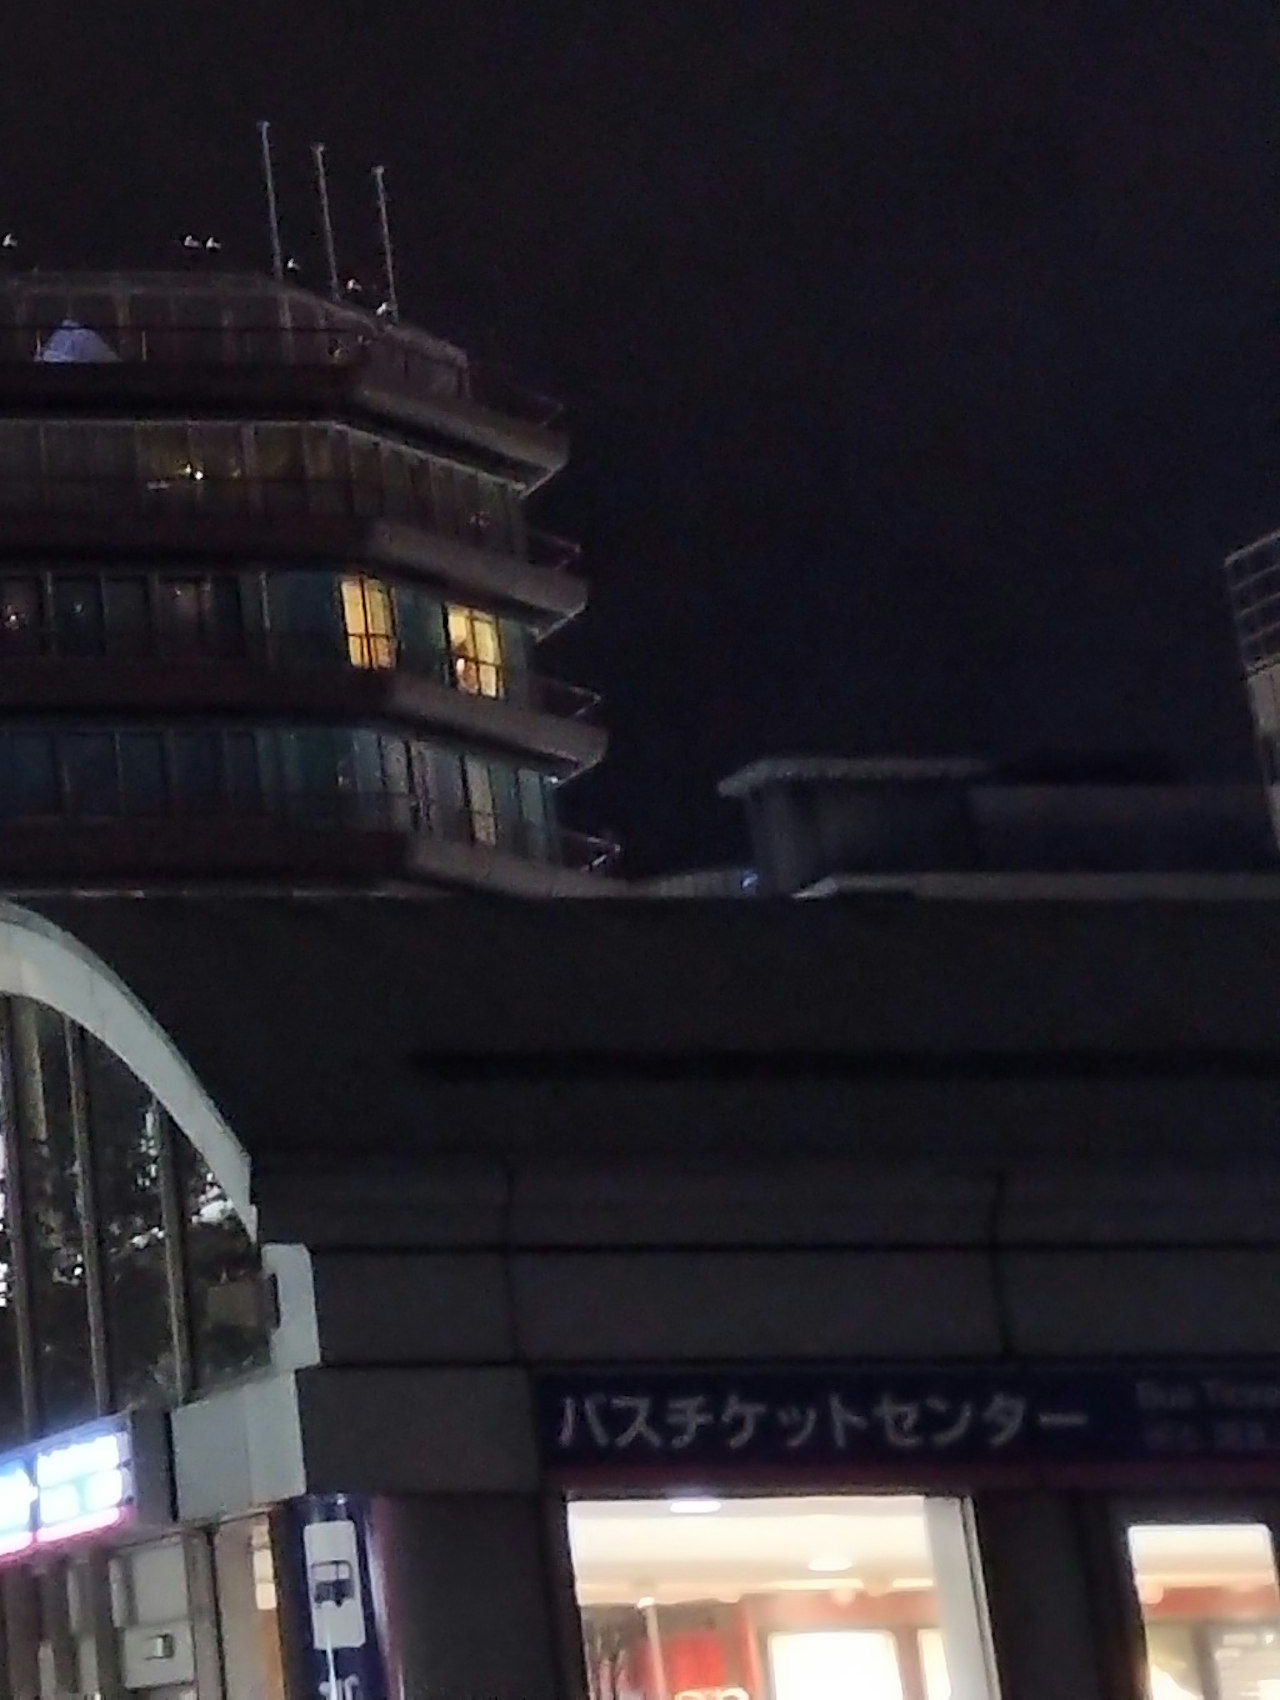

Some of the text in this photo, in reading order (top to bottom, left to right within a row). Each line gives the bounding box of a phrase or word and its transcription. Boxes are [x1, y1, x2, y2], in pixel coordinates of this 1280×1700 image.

[557, 1393, 1086, 1448] バスチケットセンター
